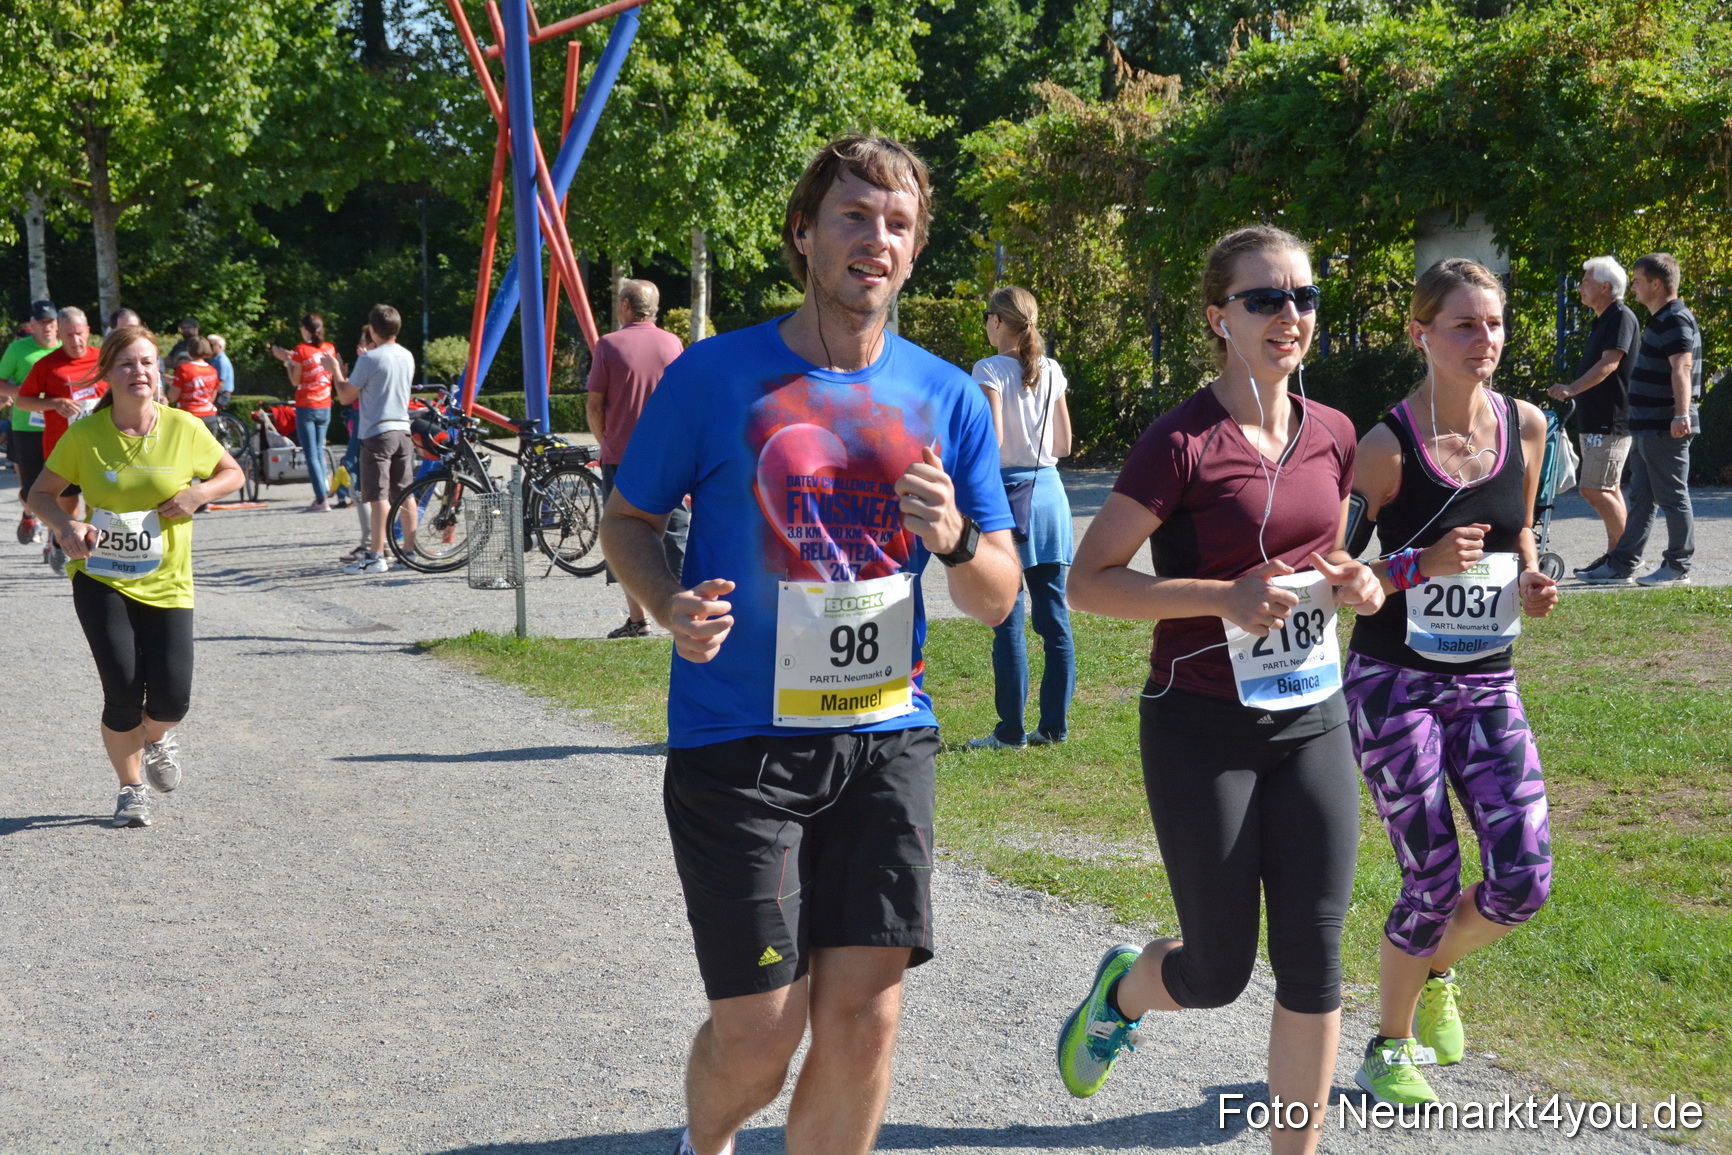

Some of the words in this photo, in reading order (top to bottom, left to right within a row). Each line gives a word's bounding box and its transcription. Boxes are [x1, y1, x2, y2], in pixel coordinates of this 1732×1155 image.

[786, 475, 818, 487] DATEV
[821, 476, 878, 492] CHALLENGE
[98, 530, 151, 552] 2550
[787, 527, 802, 538] 3.8
[880, 531, 895, 542] KM
[112, 561, 136, 572] Petra
[825, 592, 884, 613] BOCK
[1424, 584, 1502, 618] 2037
[1431, 622, 1455, 630] PARTL
[1457, 623, 1489, 631] Neumarkt
[830, 621, 879, 668] 98
[1263, 661, 1289, 671] PARTL
[810, 675, 842, 684] PARTL
[844, 670, 883, 683] Neumarkt
[1277, 674, 1320, 694] Bianca
[821, 689, 882, 711] Manuel
